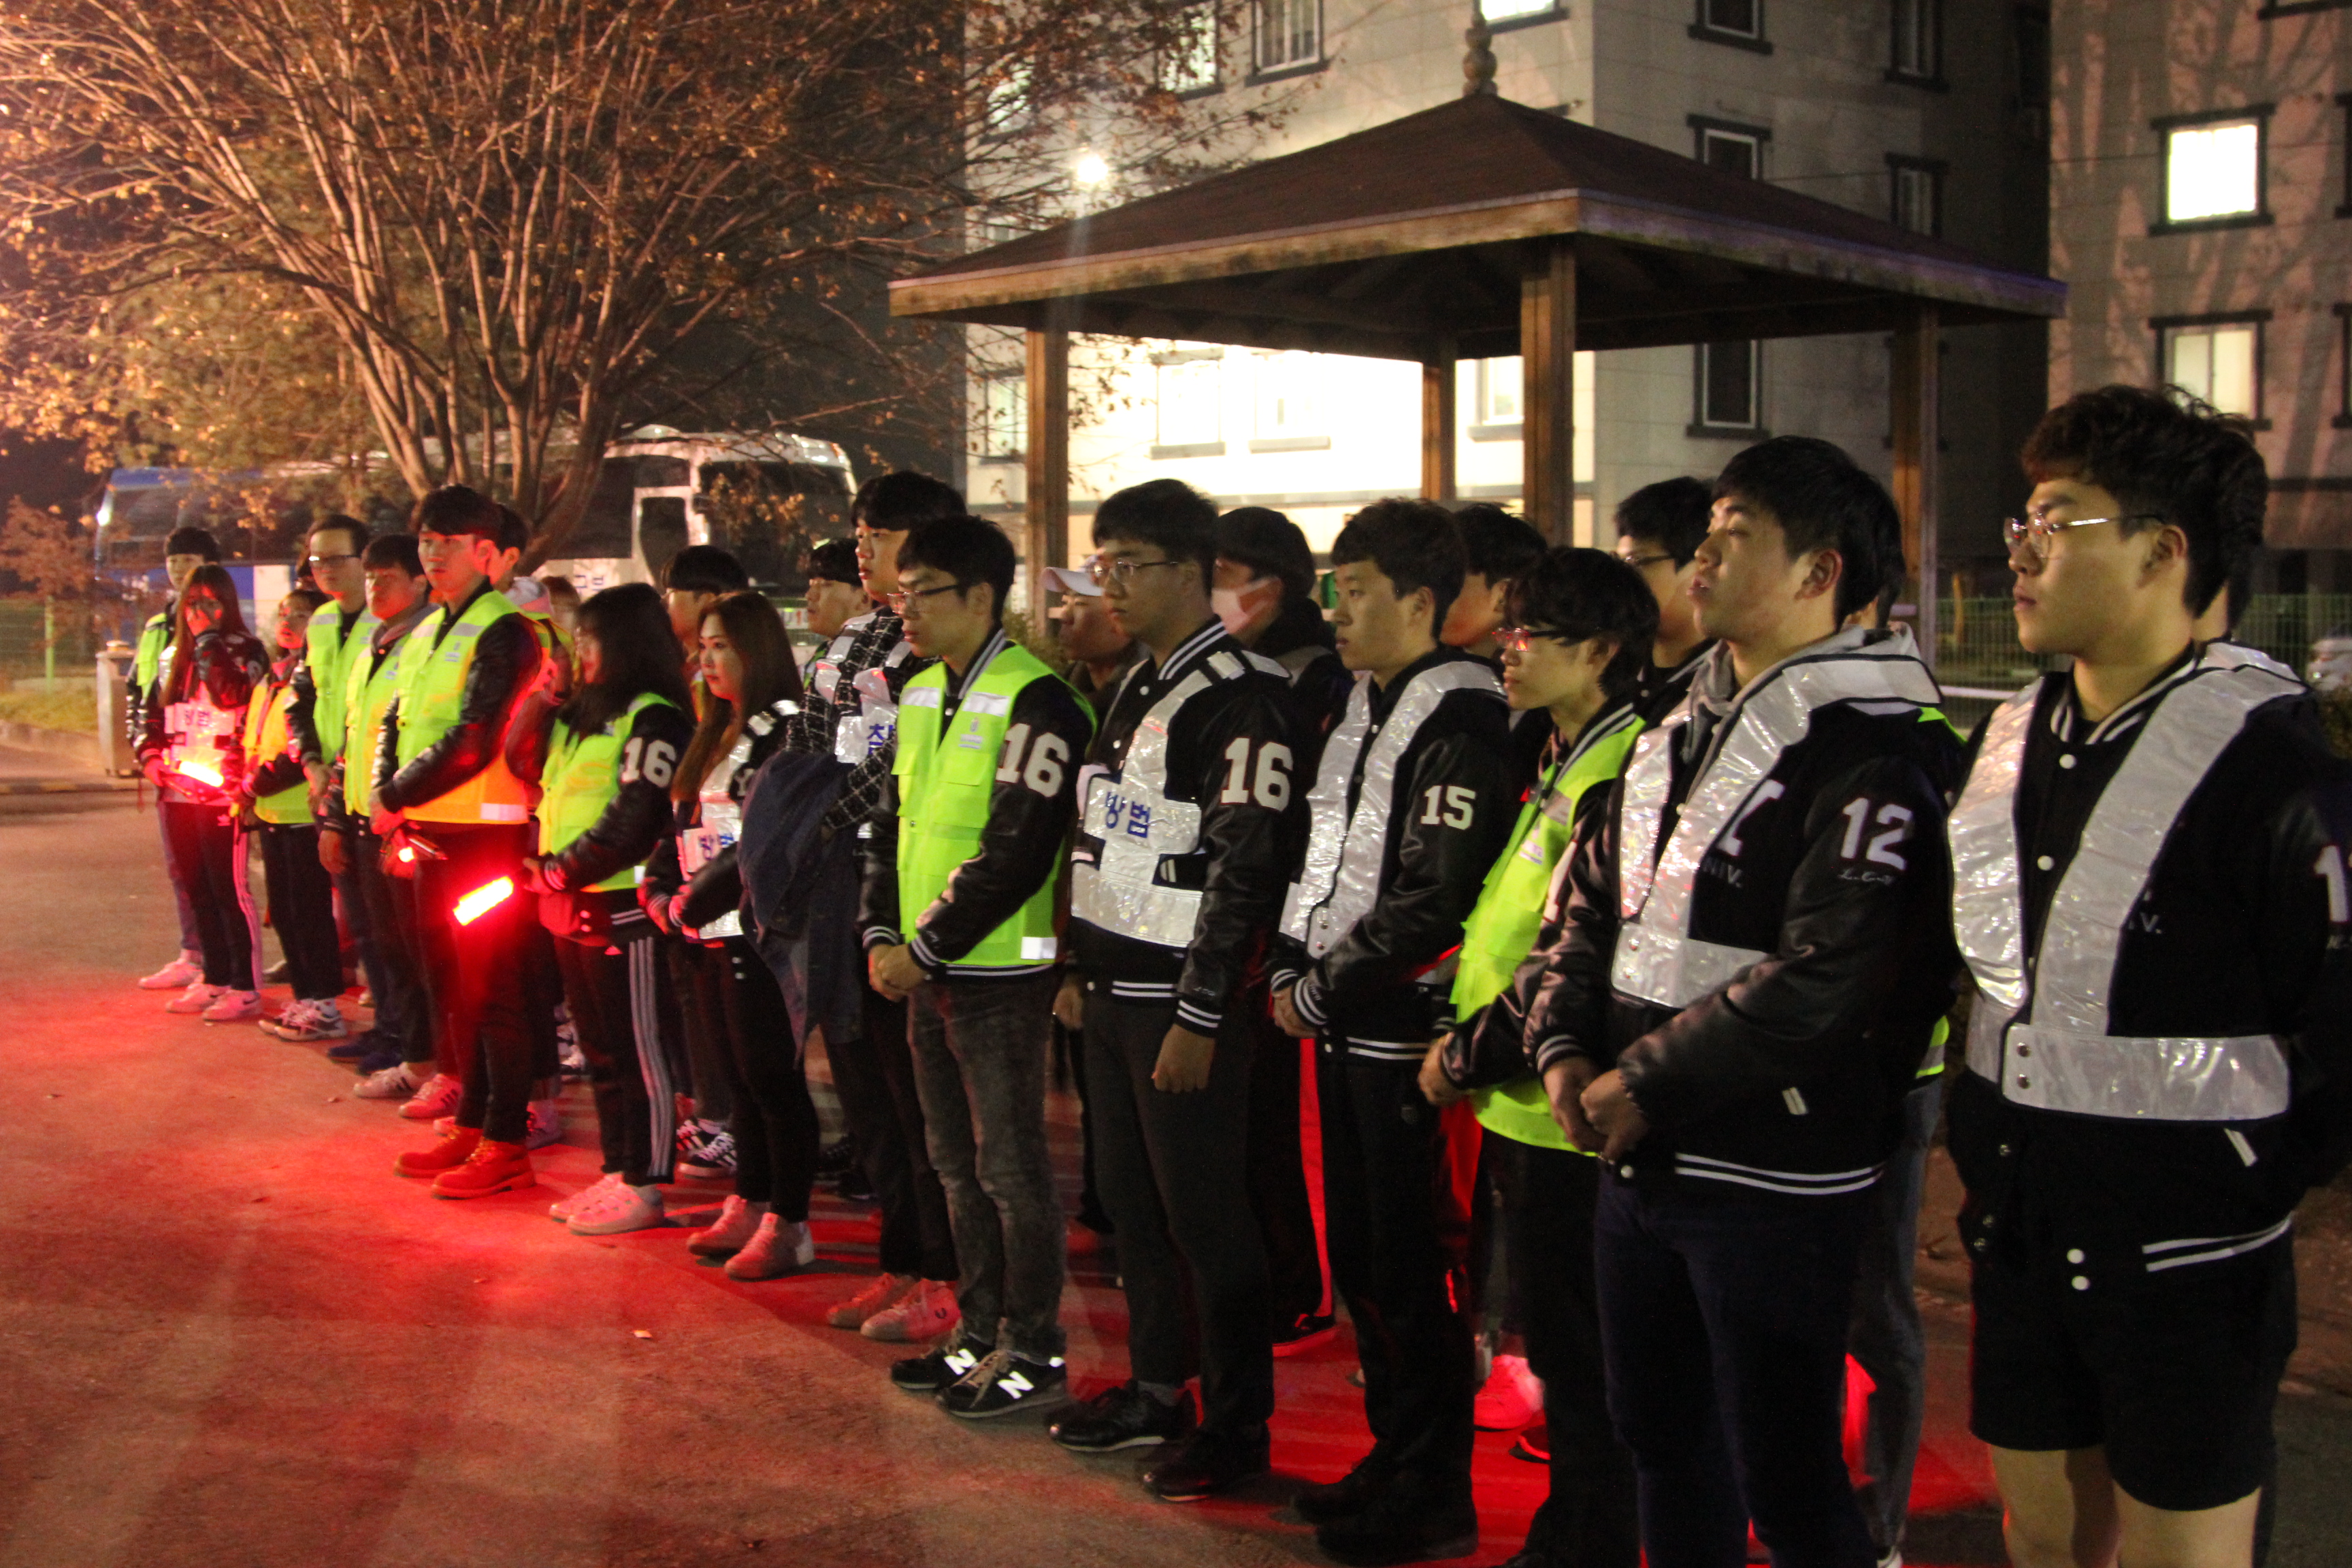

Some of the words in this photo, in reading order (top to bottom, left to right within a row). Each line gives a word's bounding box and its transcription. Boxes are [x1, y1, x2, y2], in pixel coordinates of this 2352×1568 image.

[621, 736, 677, 788] 16
[996, 723, 1070, 798] 16
[1220, 736, 1294, 813] 16
[1105, 791, 1152, 838] 방범
[1420, 785, 1477, 830] 15
[1840, 797, 1914, 870] 12
[2314, 845, 2352, 923] 1
[944, 1348, 977, 1375] N
[997, 1371, 1035, 1399] N
